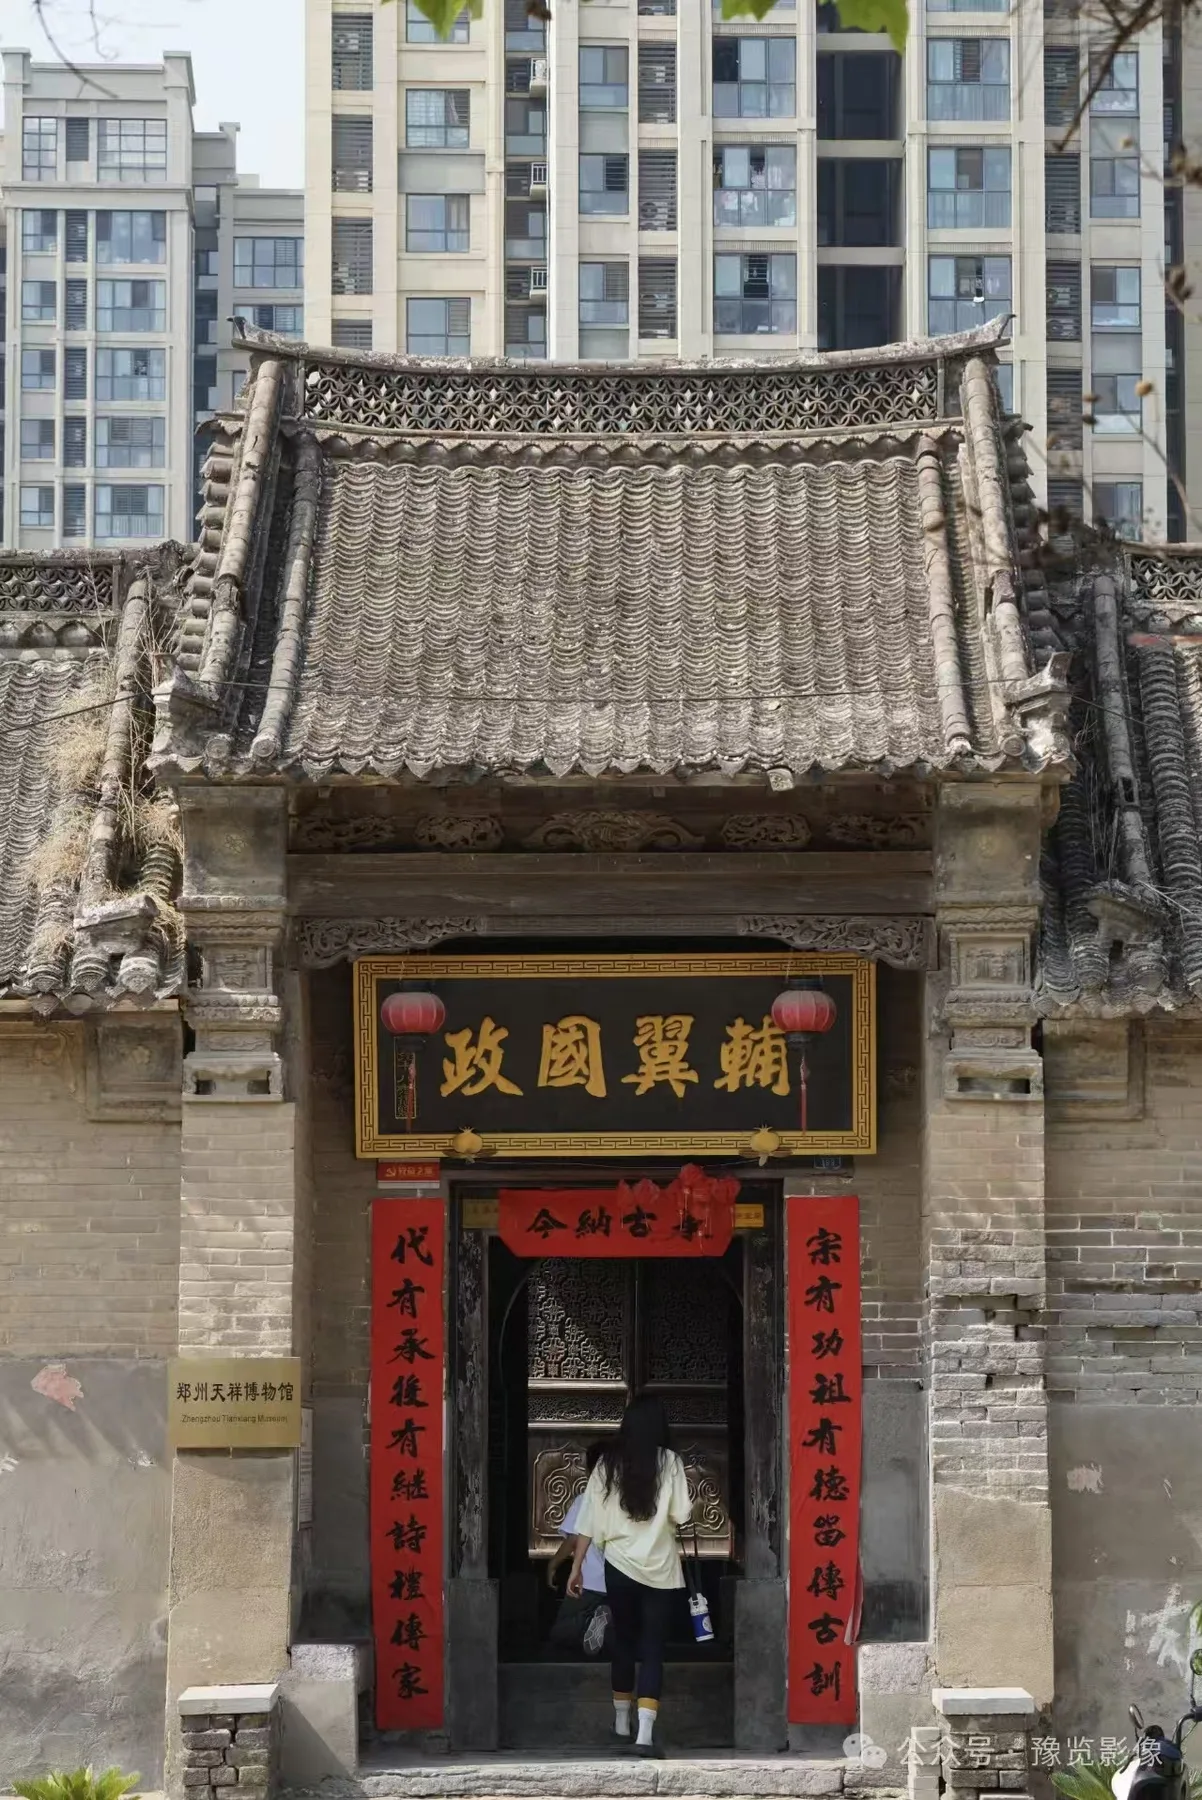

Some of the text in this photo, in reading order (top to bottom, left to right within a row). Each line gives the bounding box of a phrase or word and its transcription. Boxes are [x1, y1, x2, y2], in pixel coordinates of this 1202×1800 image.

[176, 1382, 294, 1402] 郑州天祥博物馆
[182, 1414, 220, 1424] Zhengzhou
[222, 1414, 256, 1424] Tianxiang
